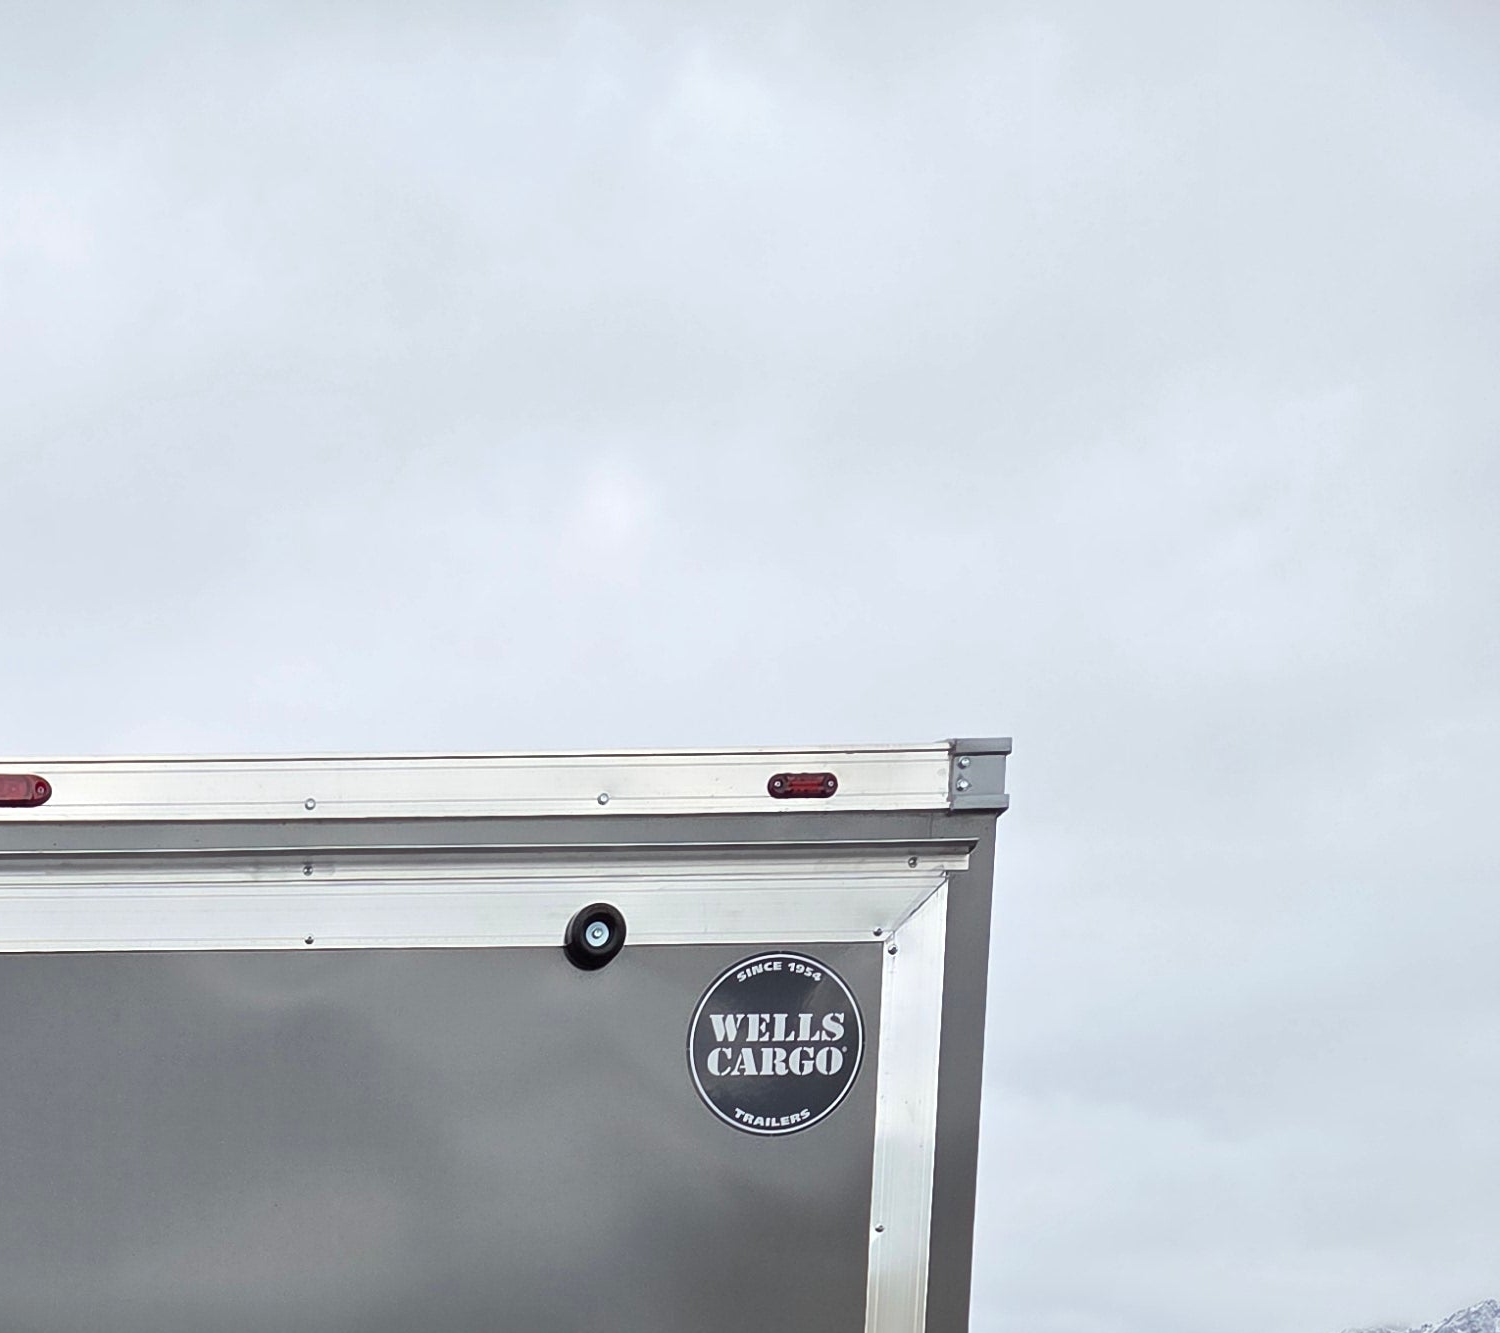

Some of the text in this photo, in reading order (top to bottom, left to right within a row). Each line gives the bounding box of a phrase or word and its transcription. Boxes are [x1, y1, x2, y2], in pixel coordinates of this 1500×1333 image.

[736, 961, 824, 983] SINCE 1954
[709, 1012, 845, 1042] WELLS
[733, 1107, 812, 1128] TRAILERS
